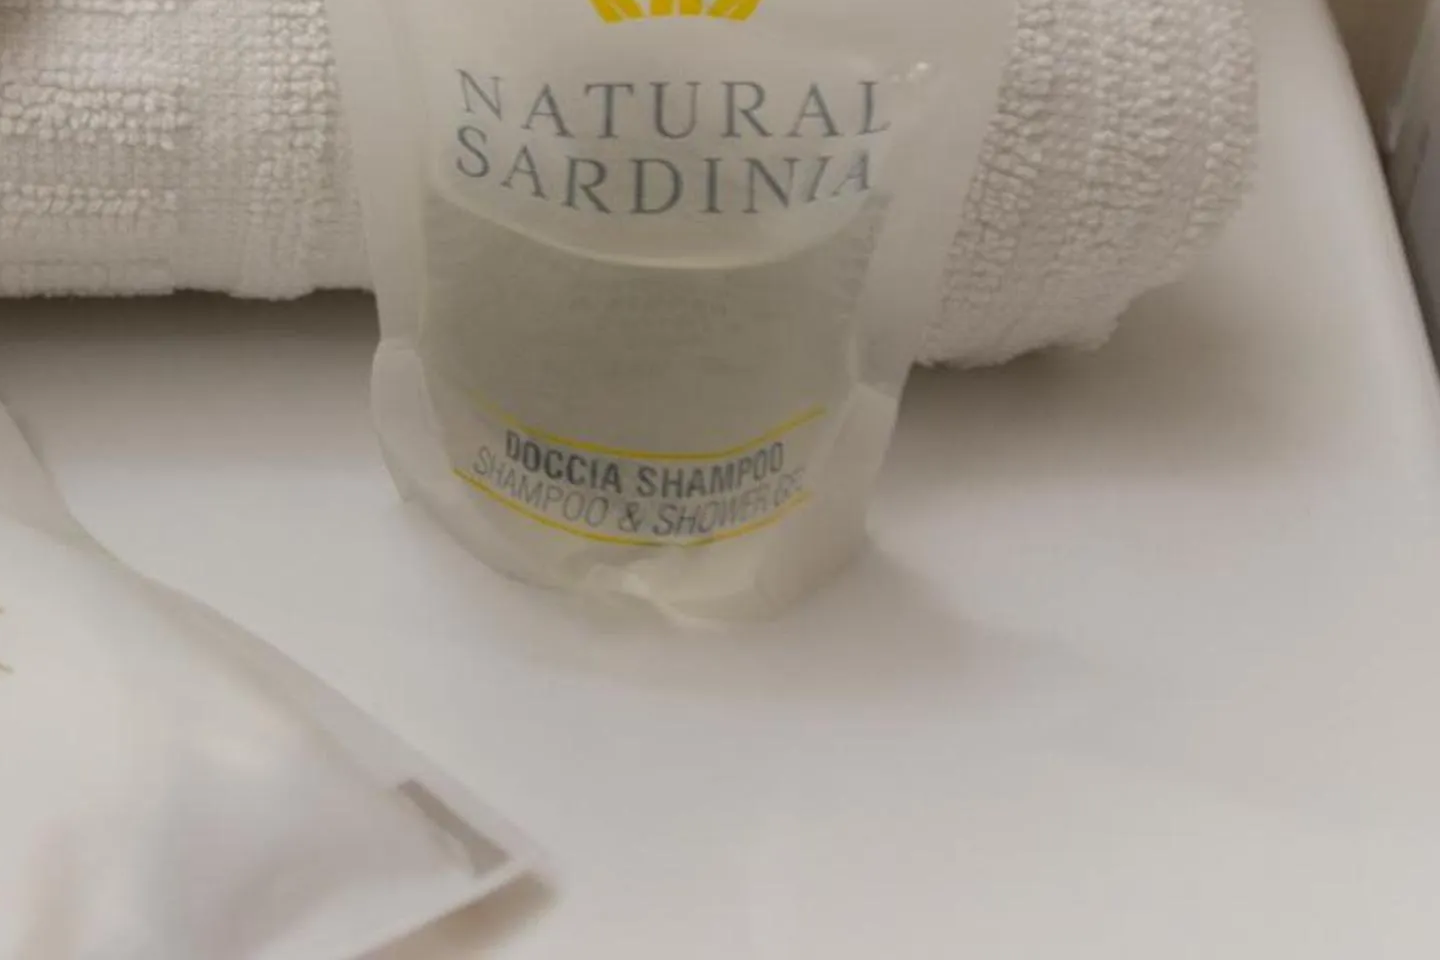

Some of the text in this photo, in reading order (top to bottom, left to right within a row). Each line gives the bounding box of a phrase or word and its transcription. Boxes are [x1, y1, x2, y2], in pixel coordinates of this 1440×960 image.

[455, 69, 892, 140] NATURAL
[455, 125, 872, 215] SARDINIA
[472, 445, 609, 527] SHAMPOO
[618, 501, 643, 533] &
[652, 483, 769, 536] SHOWER
[506, 431, 784, 498] DOCCIA SHAMPOO
